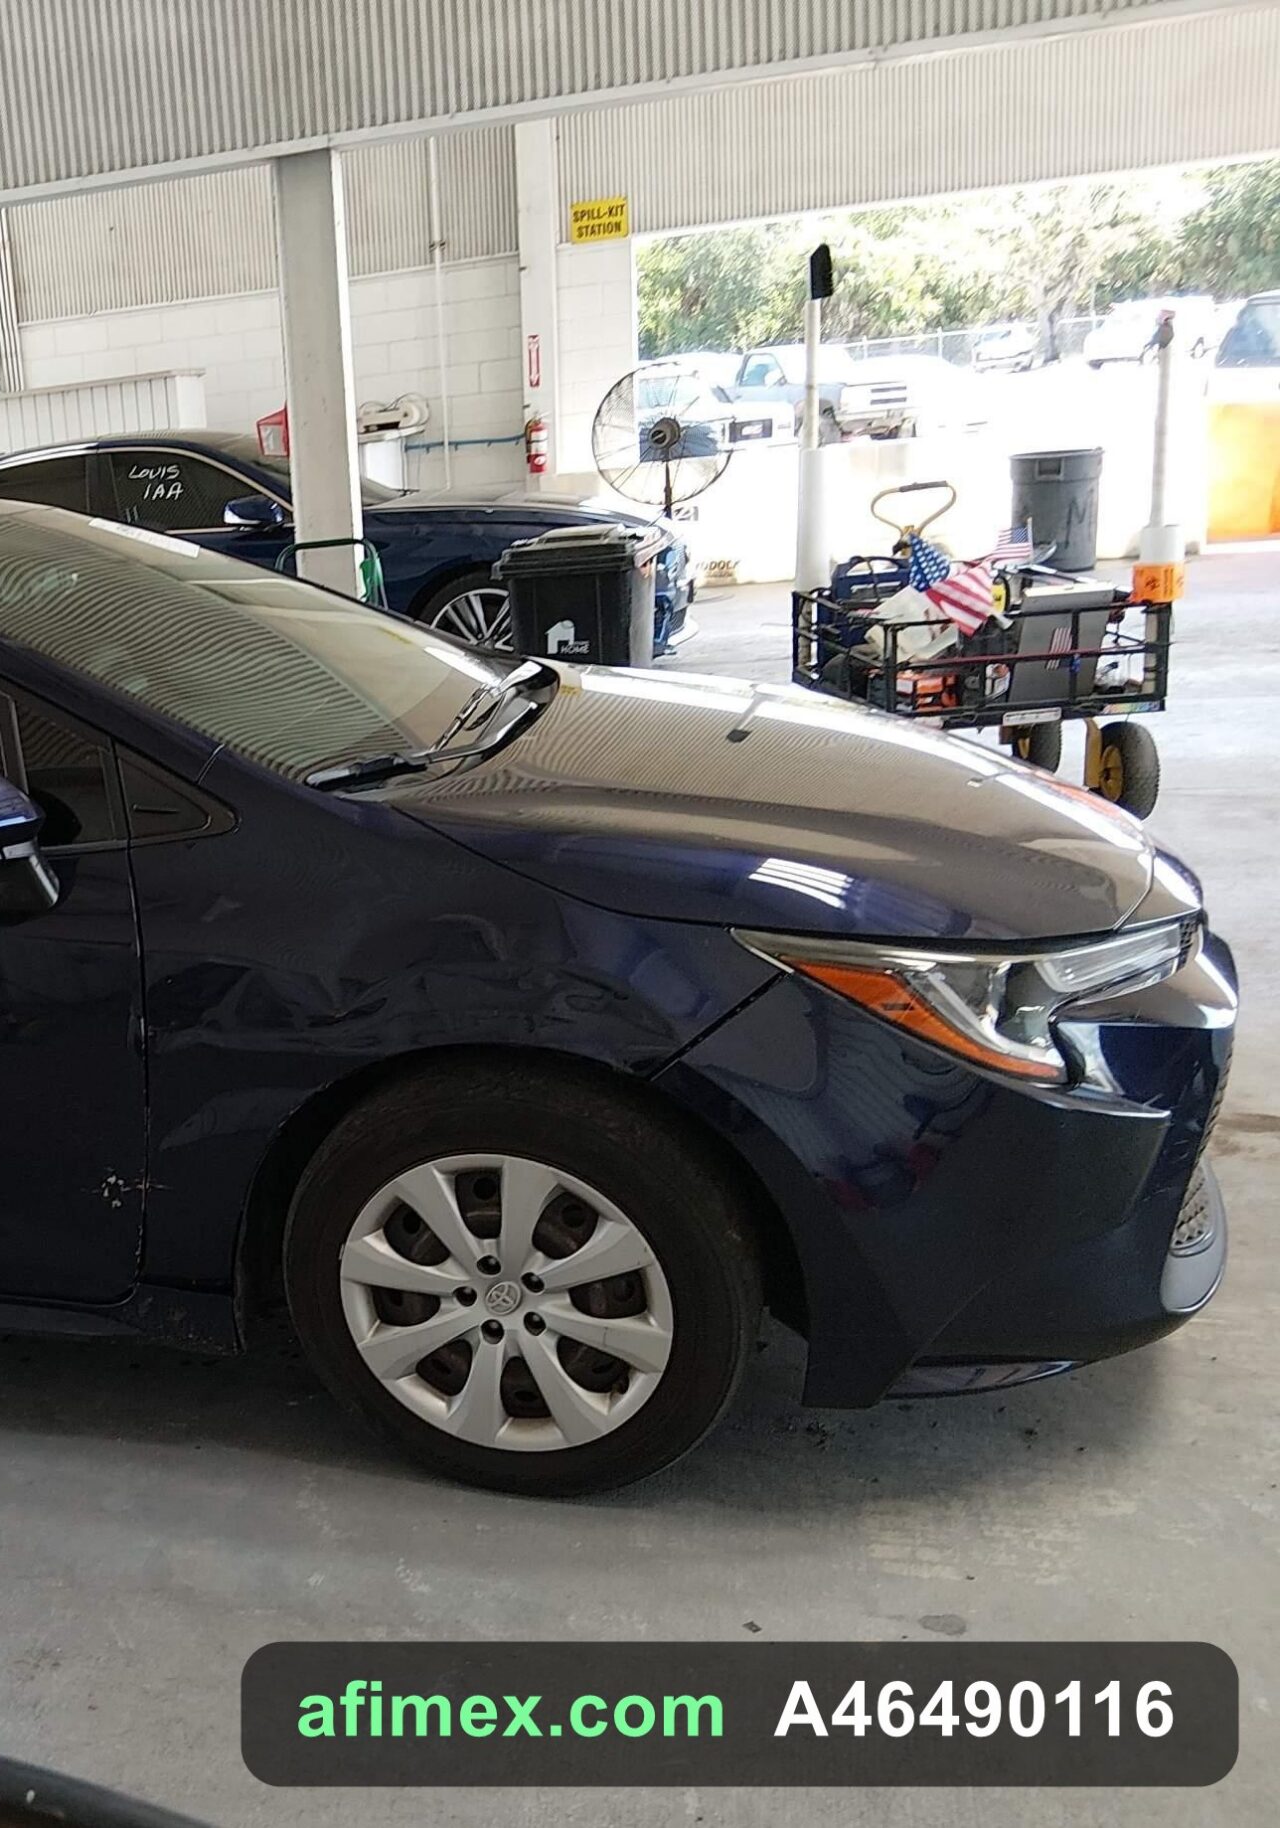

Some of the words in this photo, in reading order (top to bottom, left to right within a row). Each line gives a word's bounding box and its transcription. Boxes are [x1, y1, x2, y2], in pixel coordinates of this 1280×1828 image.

[573, 204, 625, 222] SPILL-KIT
[577, 221, 622, 238] STATION
[128, 464, 181, 480] LOUIS
